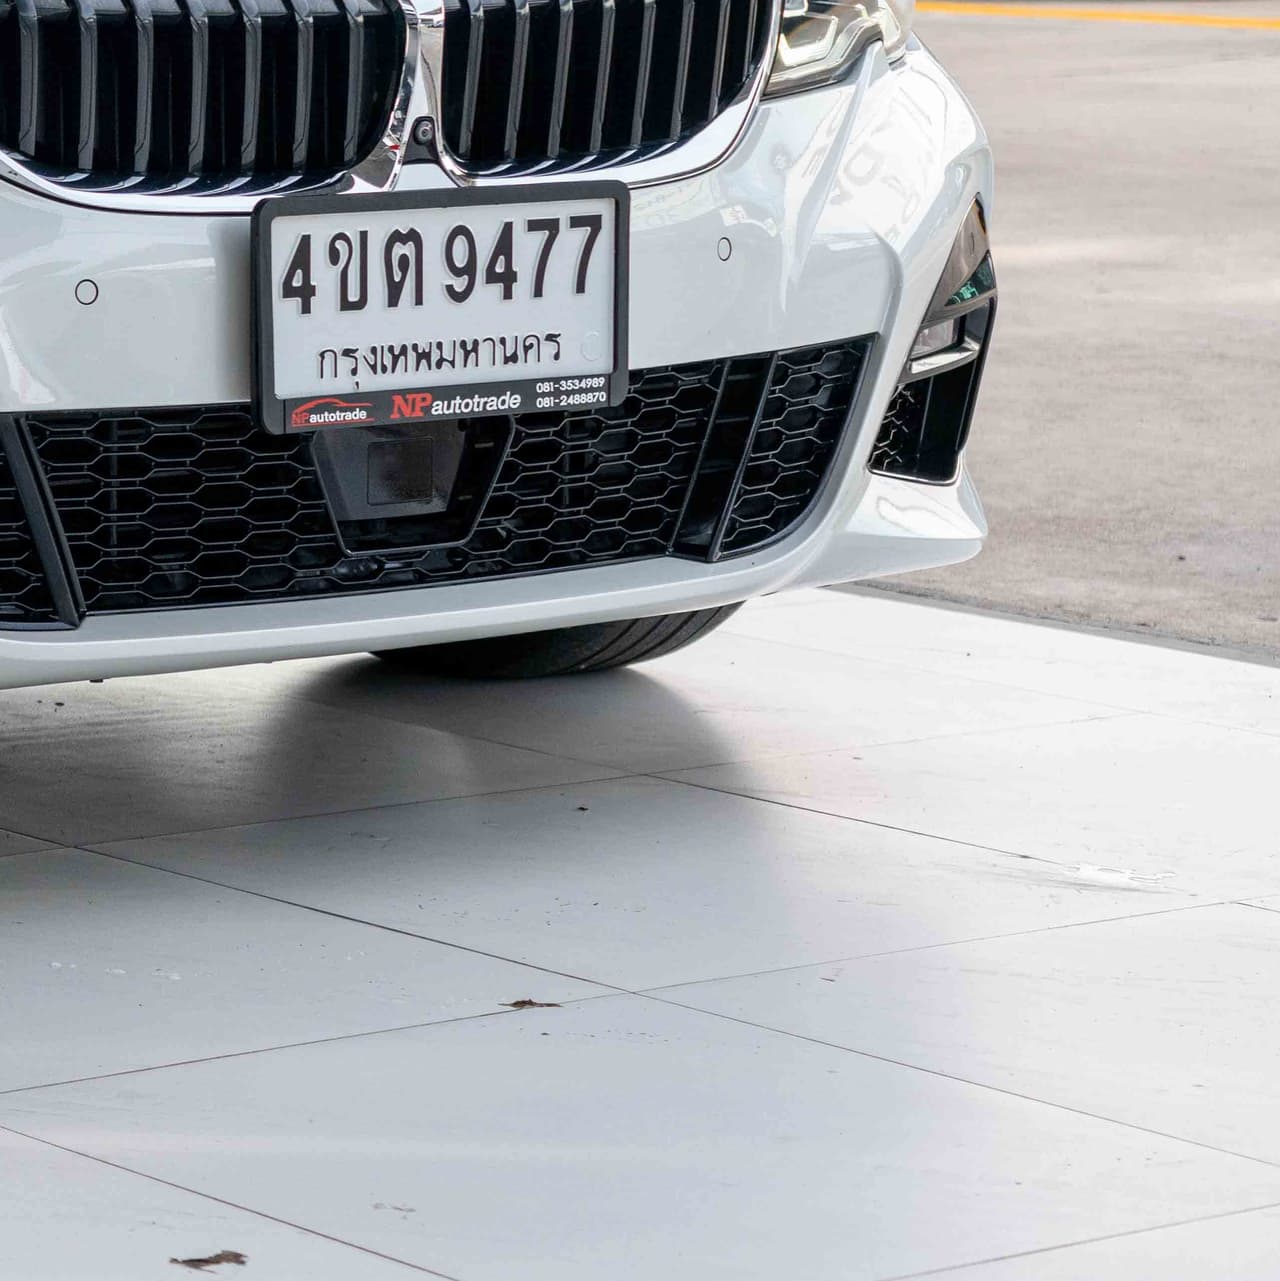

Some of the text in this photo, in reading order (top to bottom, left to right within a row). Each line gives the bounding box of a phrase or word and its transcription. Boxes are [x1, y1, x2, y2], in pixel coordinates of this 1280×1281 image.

[281, 214, 603, 316] 4ขต 9477
[318, 331, 561, 390] กรุงเทพมหานคร
[536, 377, 605, 394] 081-3534989
[536, 391, 606, 408] 081-2488870
